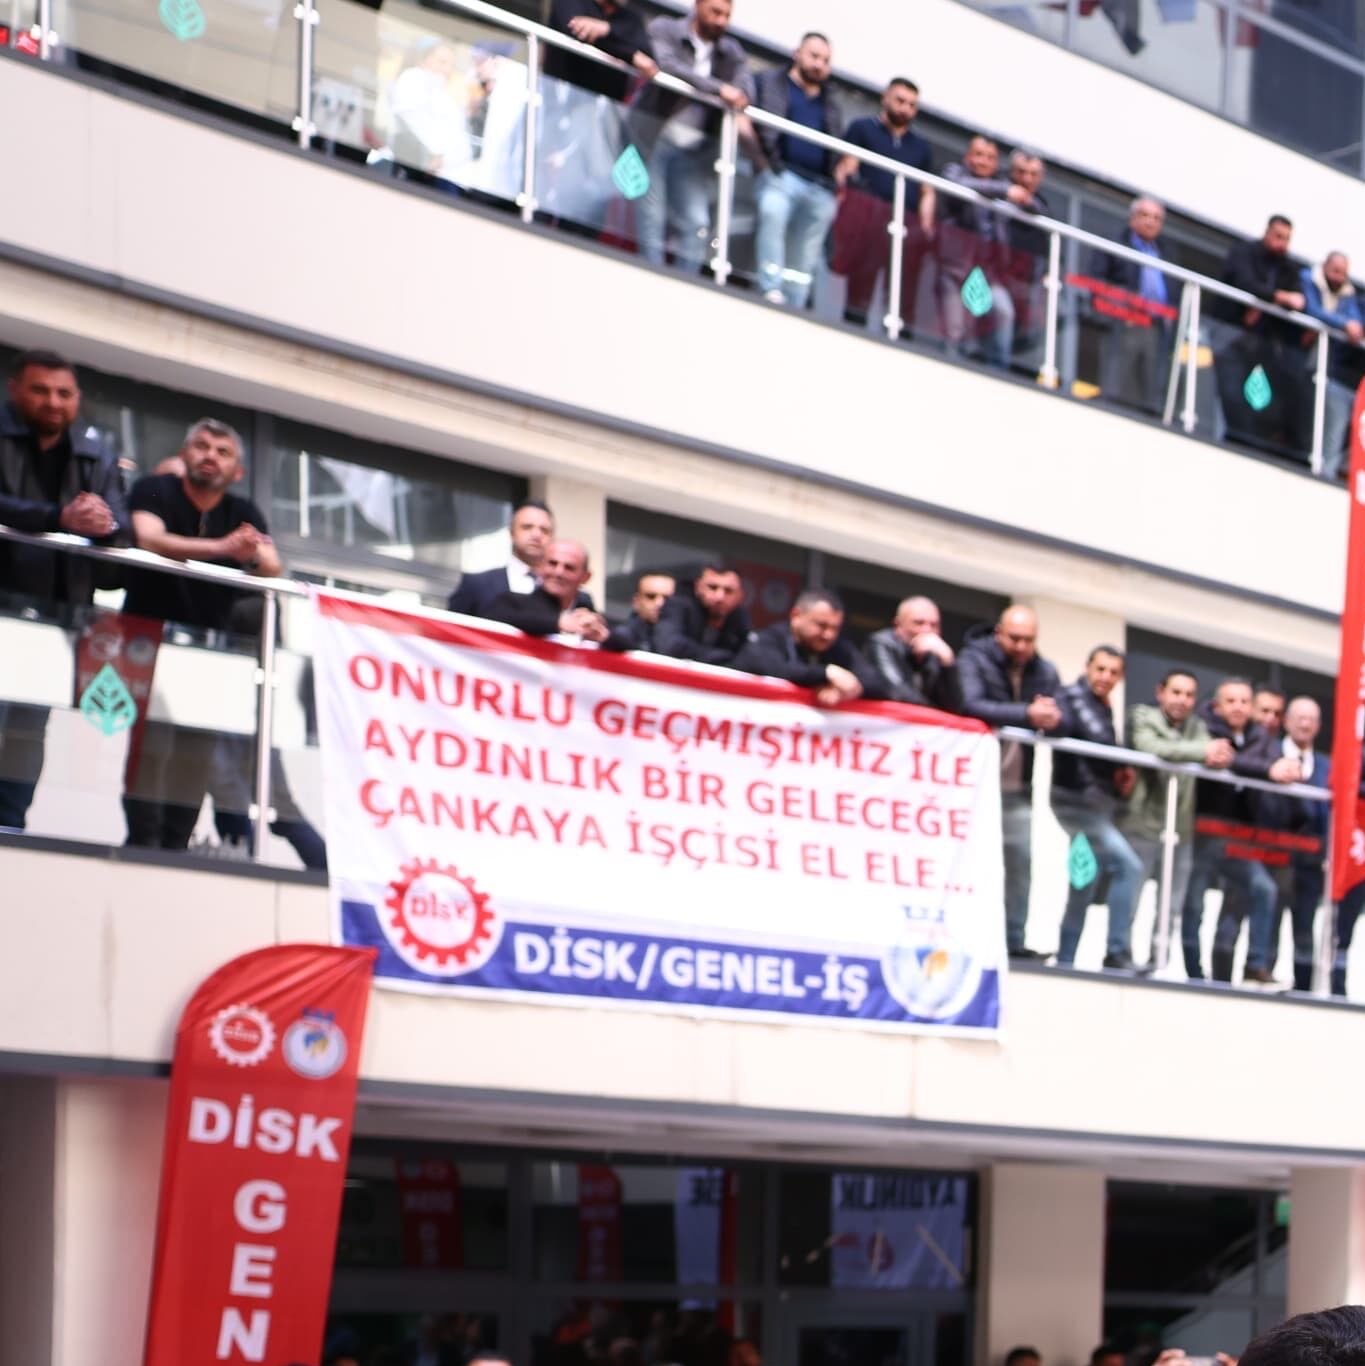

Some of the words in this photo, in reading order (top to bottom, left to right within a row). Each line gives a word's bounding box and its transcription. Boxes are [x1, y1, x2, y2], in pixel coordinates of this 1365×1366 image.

[349, 654, 575, 727] ONURLU
[592, 698, 893, 777] GEÇMİŞİMİZ
[910, 739, 975, 787] İLE
[358, 778, 608, 849] ÇANKAYA
[625, 809, 781, 870] İŞÇİSİ
[801, 844, 848, 880] EL
[364, 718, 623, 794] AYDINLIK
[641, 759, 727, 808] BİR
[746, 778, 971, 842] GELECEĞE
[513, 928, 870, 1007] DİSK/GENEL-İŞ
[188, 1094, 344, 1161] DİSK
